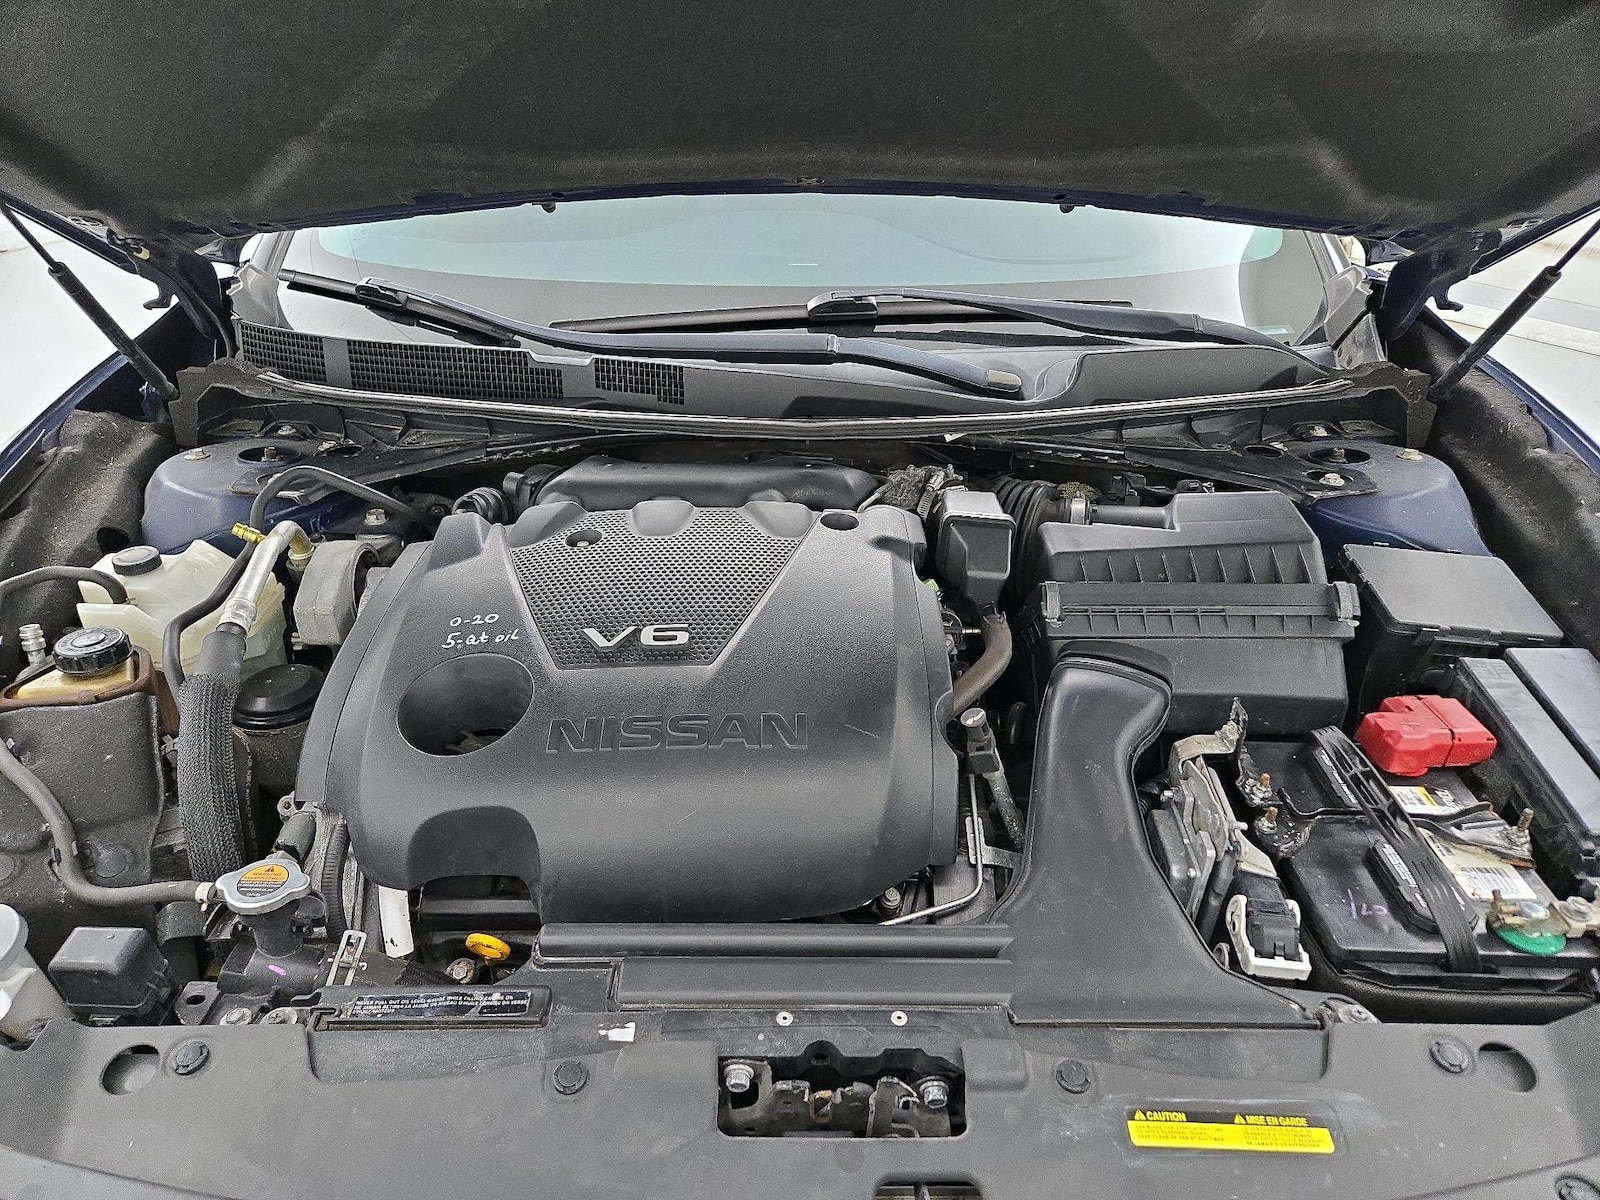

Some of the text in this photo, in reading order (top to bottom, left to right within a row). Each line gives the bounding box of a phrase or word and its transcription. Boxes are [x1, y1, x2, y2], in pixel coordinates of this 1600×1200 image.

[449, 613, 500, 627] 0-20
[583, 623, 690, 649] V6
[546, 712, 808, 754] NISSAN
[1145, 1110, 1187, 1122] CAUTION
[1245, 1114, 1309, 1127] MISE EN GARDE
